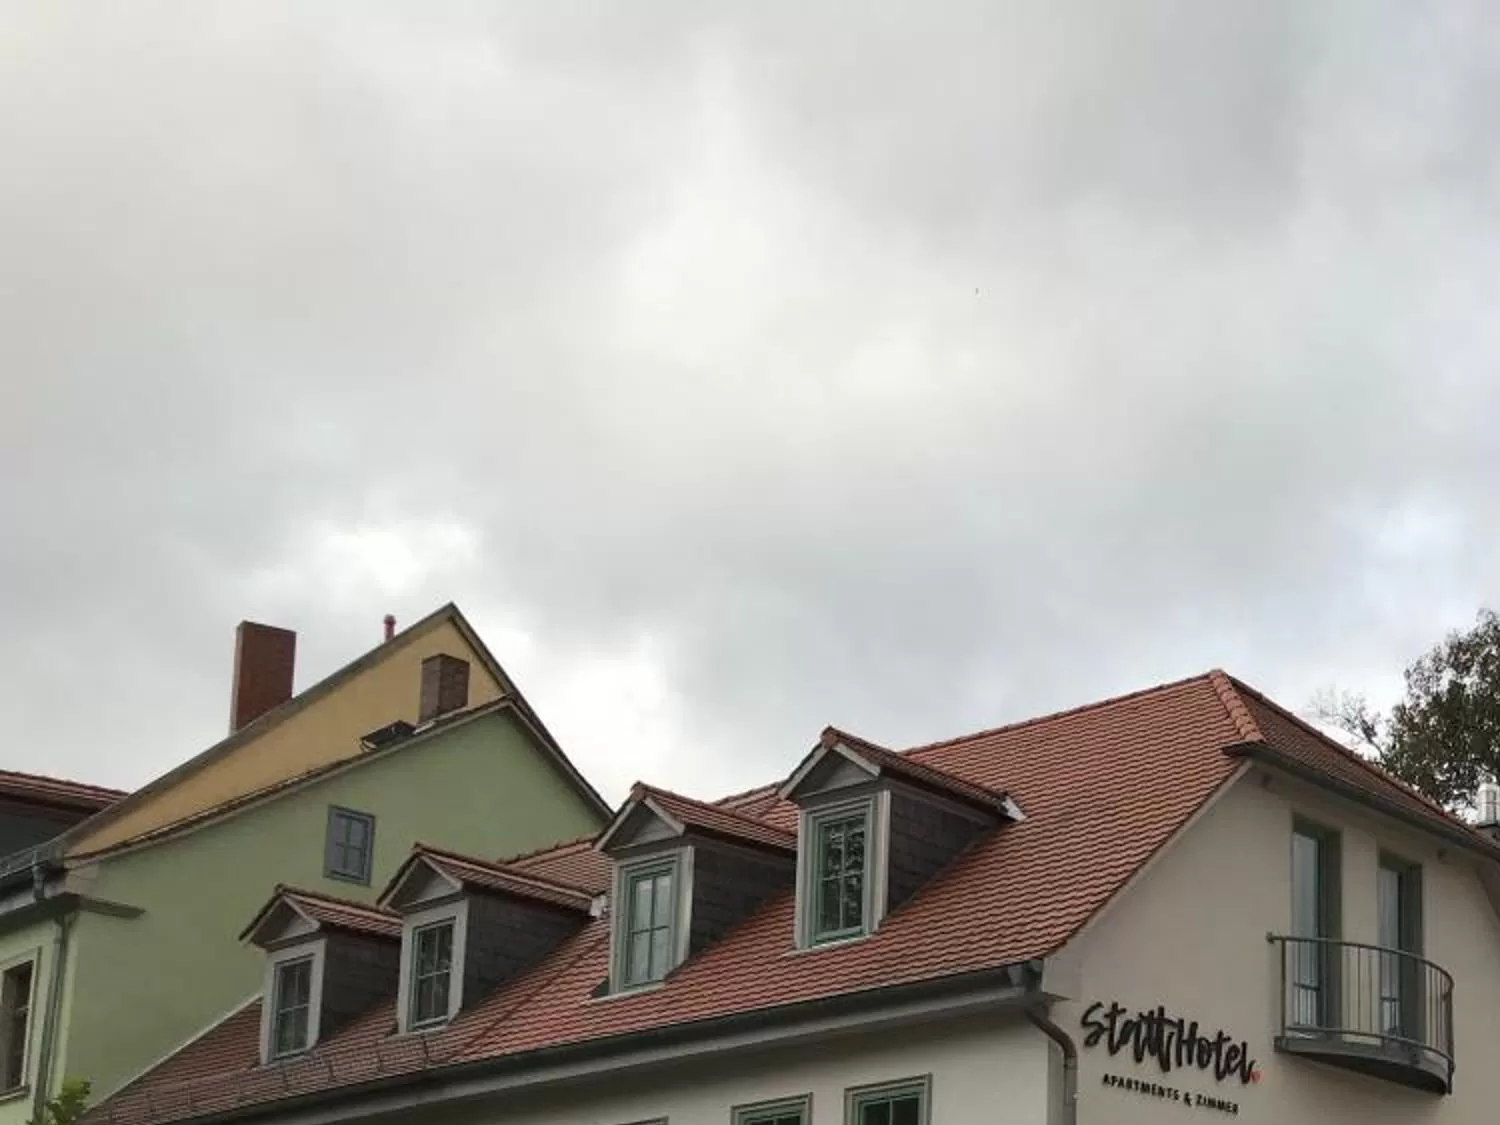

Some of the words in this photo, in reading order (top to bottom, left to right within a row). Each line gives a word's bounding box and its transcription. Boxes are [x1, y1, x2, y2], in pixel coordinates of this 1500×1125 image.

[1103, 1073, 1180, 1101] APARTMENTS
[1183, 1091, 1192, 1107] &
[1195, 1094, 1239, 1115] ZIMMER
